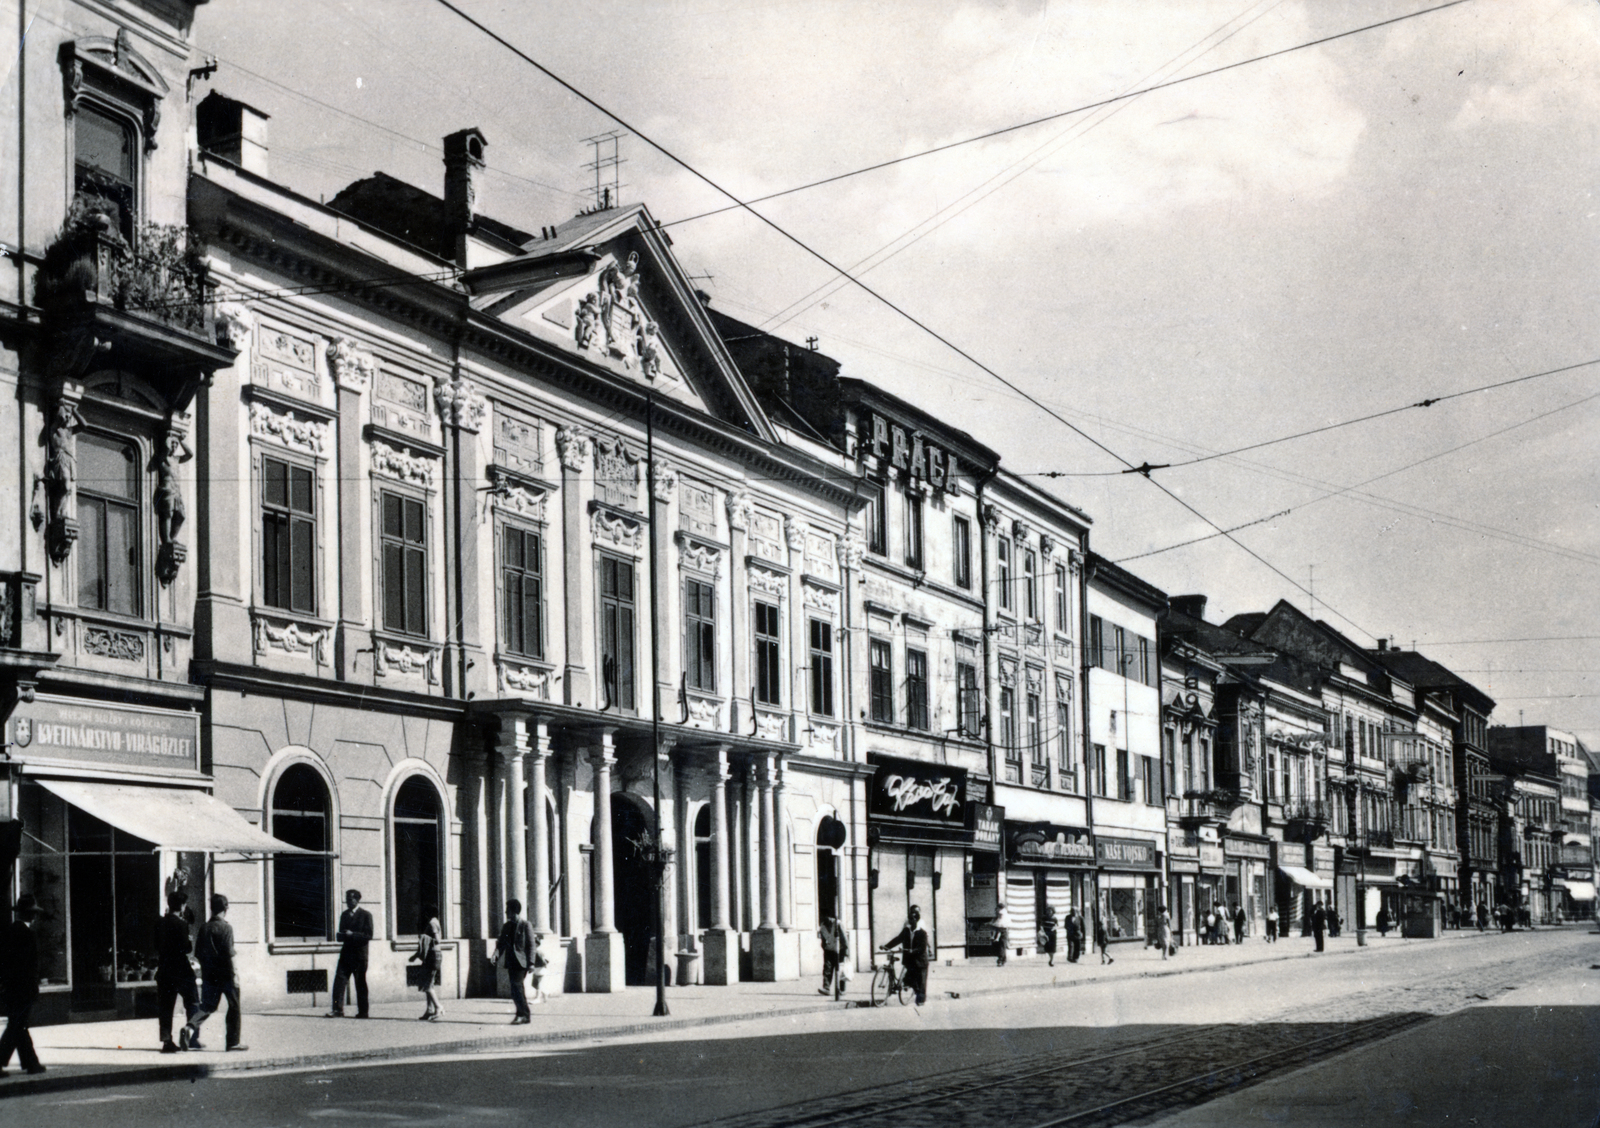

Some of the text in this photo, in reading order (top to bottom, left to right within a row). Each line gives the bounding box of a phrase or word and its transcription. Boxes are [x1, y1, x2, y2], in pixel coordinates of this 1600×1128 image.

[978, 819, 999, 832] TABAK
[1104, 841, 1121, 860] NAŠE
[1122, 843, 1148, 865] VOJSKO
